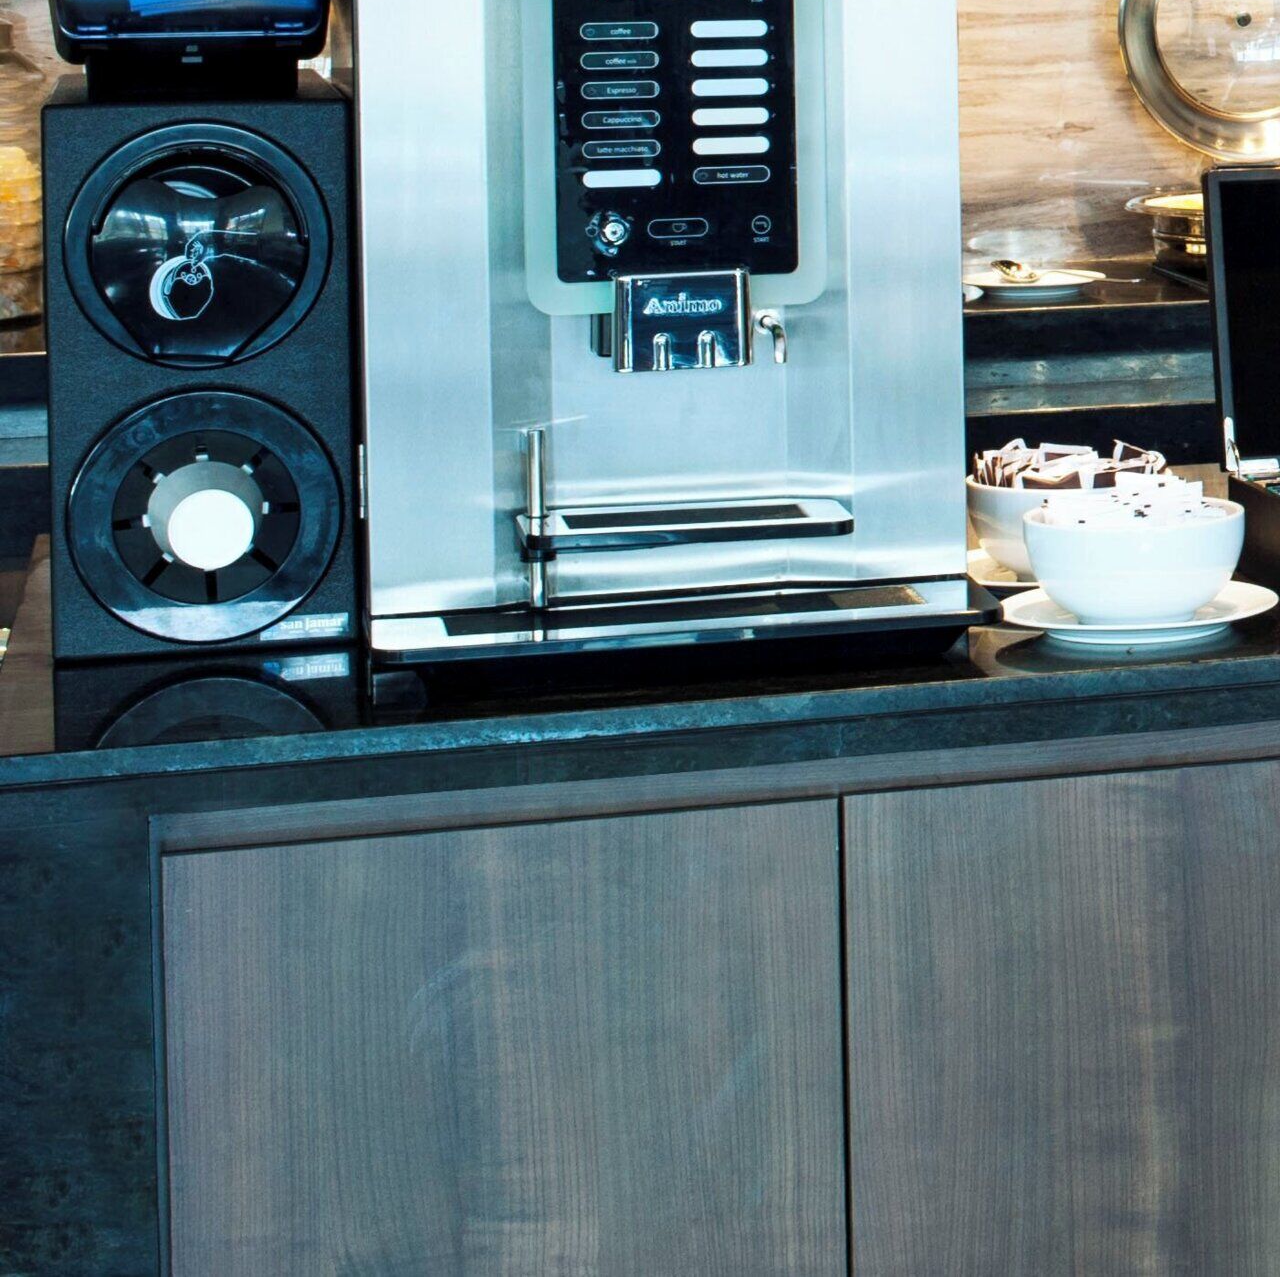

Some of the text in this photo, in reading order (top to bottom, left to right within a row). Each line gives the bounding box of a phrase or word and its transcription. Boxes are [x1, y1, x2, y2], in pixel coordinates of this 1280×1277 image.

[605, 57, 626, 65] coffee
[606, 86, 637, 95] Espresso
[602, 116, 642, 124] Cappuccino
[643, 292, 723, 315] Animo
